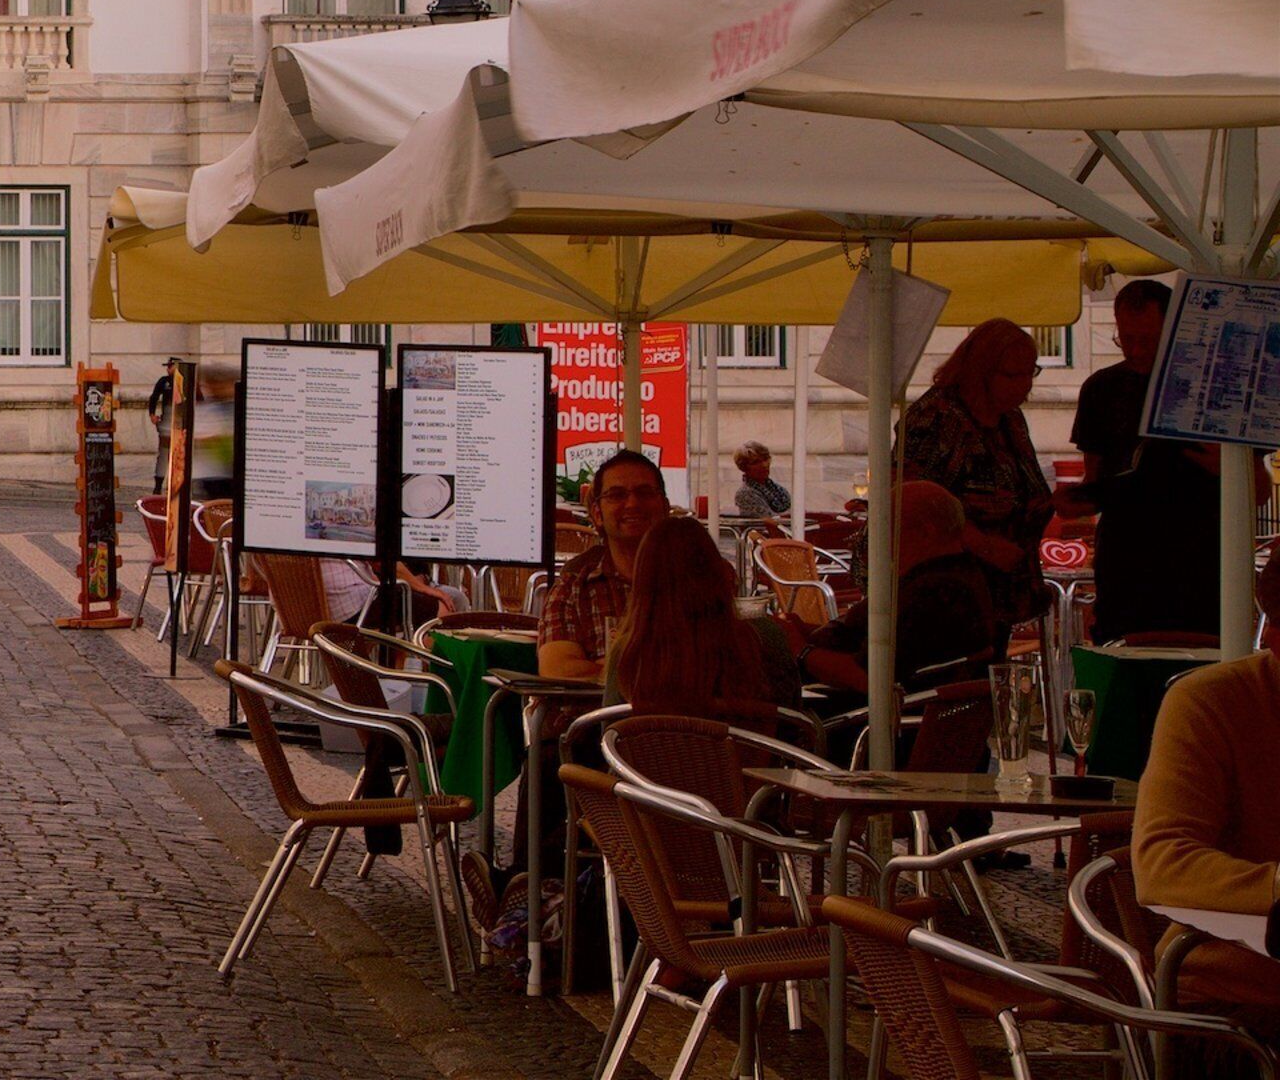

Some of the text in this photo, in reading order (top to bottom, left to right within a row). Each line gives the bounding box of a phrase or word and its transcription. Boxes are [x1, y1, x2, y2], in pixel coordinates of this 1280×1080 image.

[652, 351, 681, 364] PCP
[551, 374, 655, 407] roduço
[557, 406, 661, 434] oberaia
